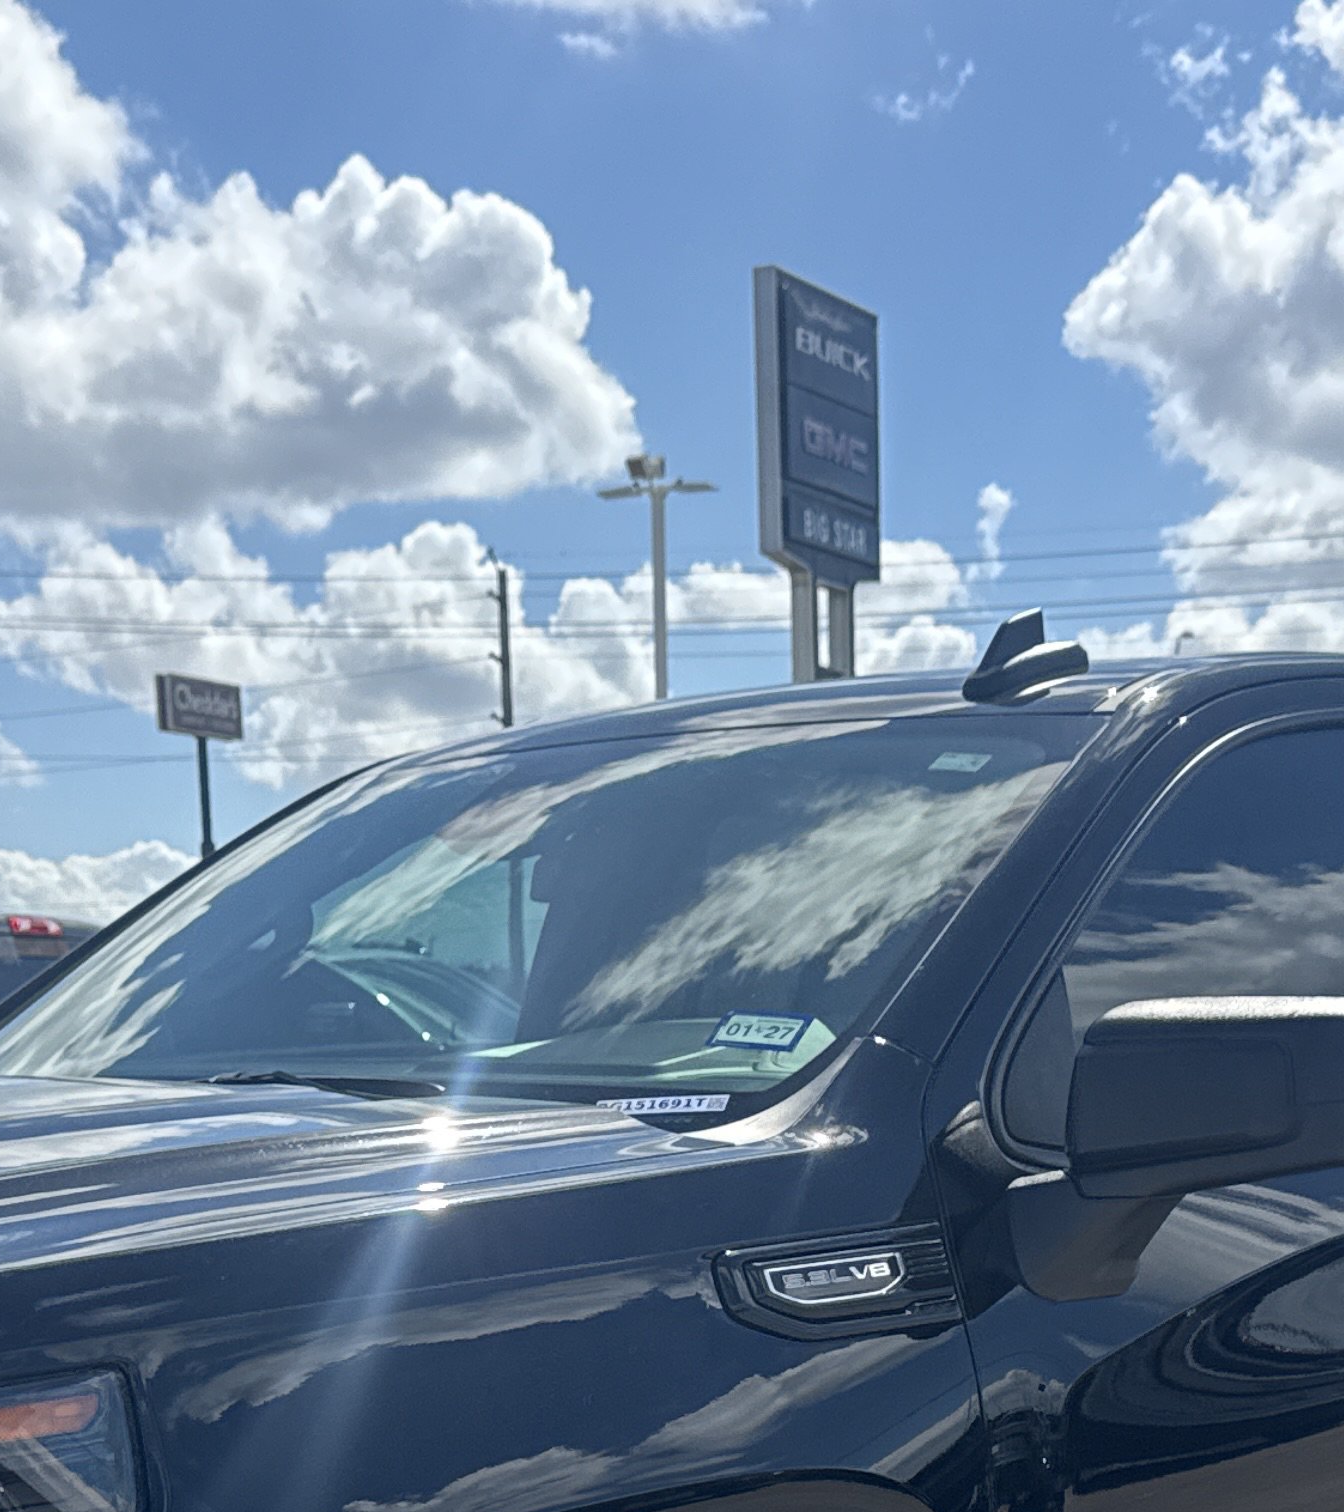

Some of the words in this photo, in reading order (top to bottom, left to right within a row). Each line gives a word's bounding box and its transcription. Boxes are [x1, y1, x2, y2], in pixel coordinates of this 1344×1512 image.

[796, 326, 871, 381] BUICK
[802, 418, 868, 474] GMC
[725, 1022, 753, 1037] 01
[763, 1025, 796, 1040] 27
